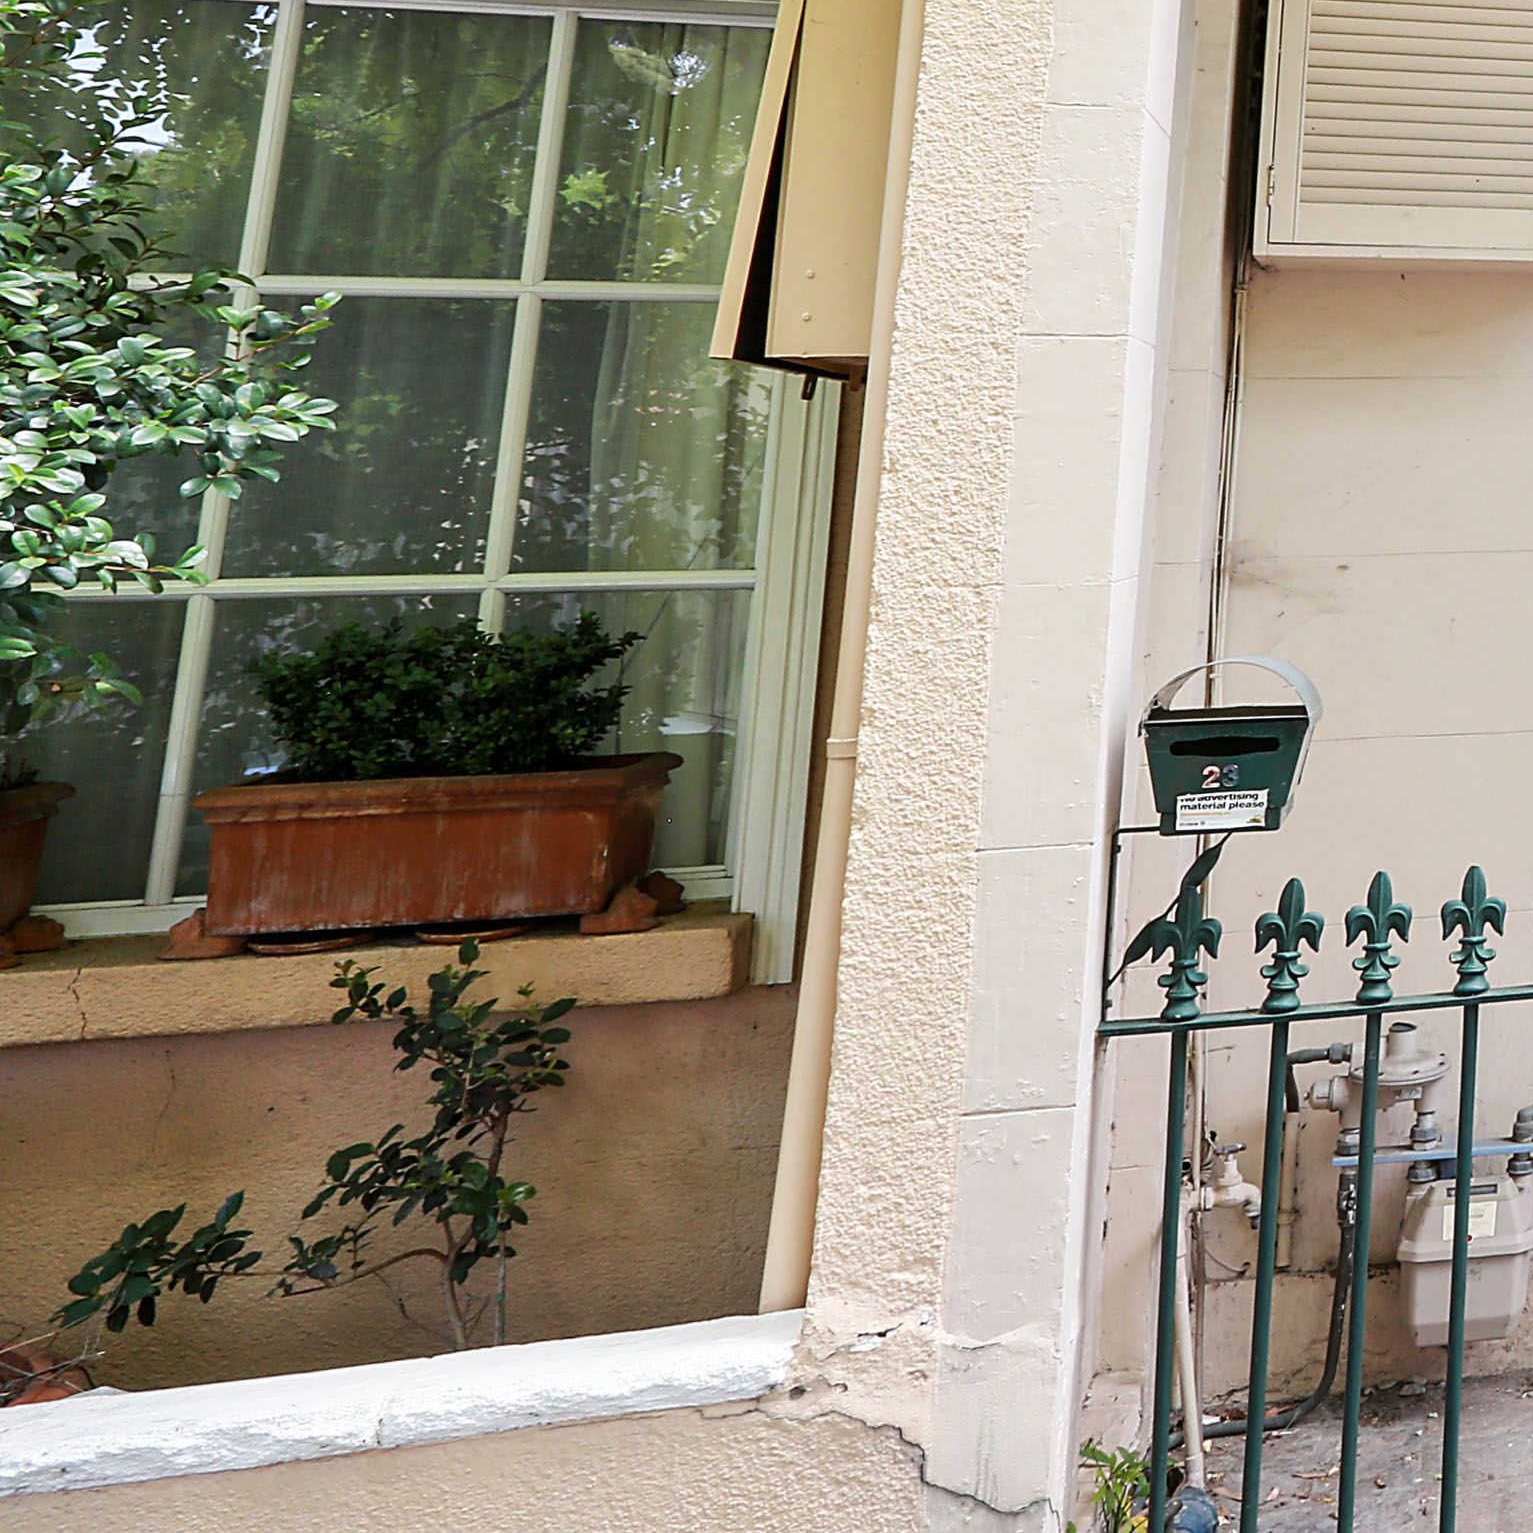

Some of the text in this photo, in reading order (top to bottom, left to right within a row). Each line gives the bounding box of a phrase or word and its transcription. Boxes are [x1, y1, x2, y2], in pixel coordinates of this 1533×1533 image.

[1201, 764, 1240, 789] 23
[1180, 801, 1265, 811] material please
